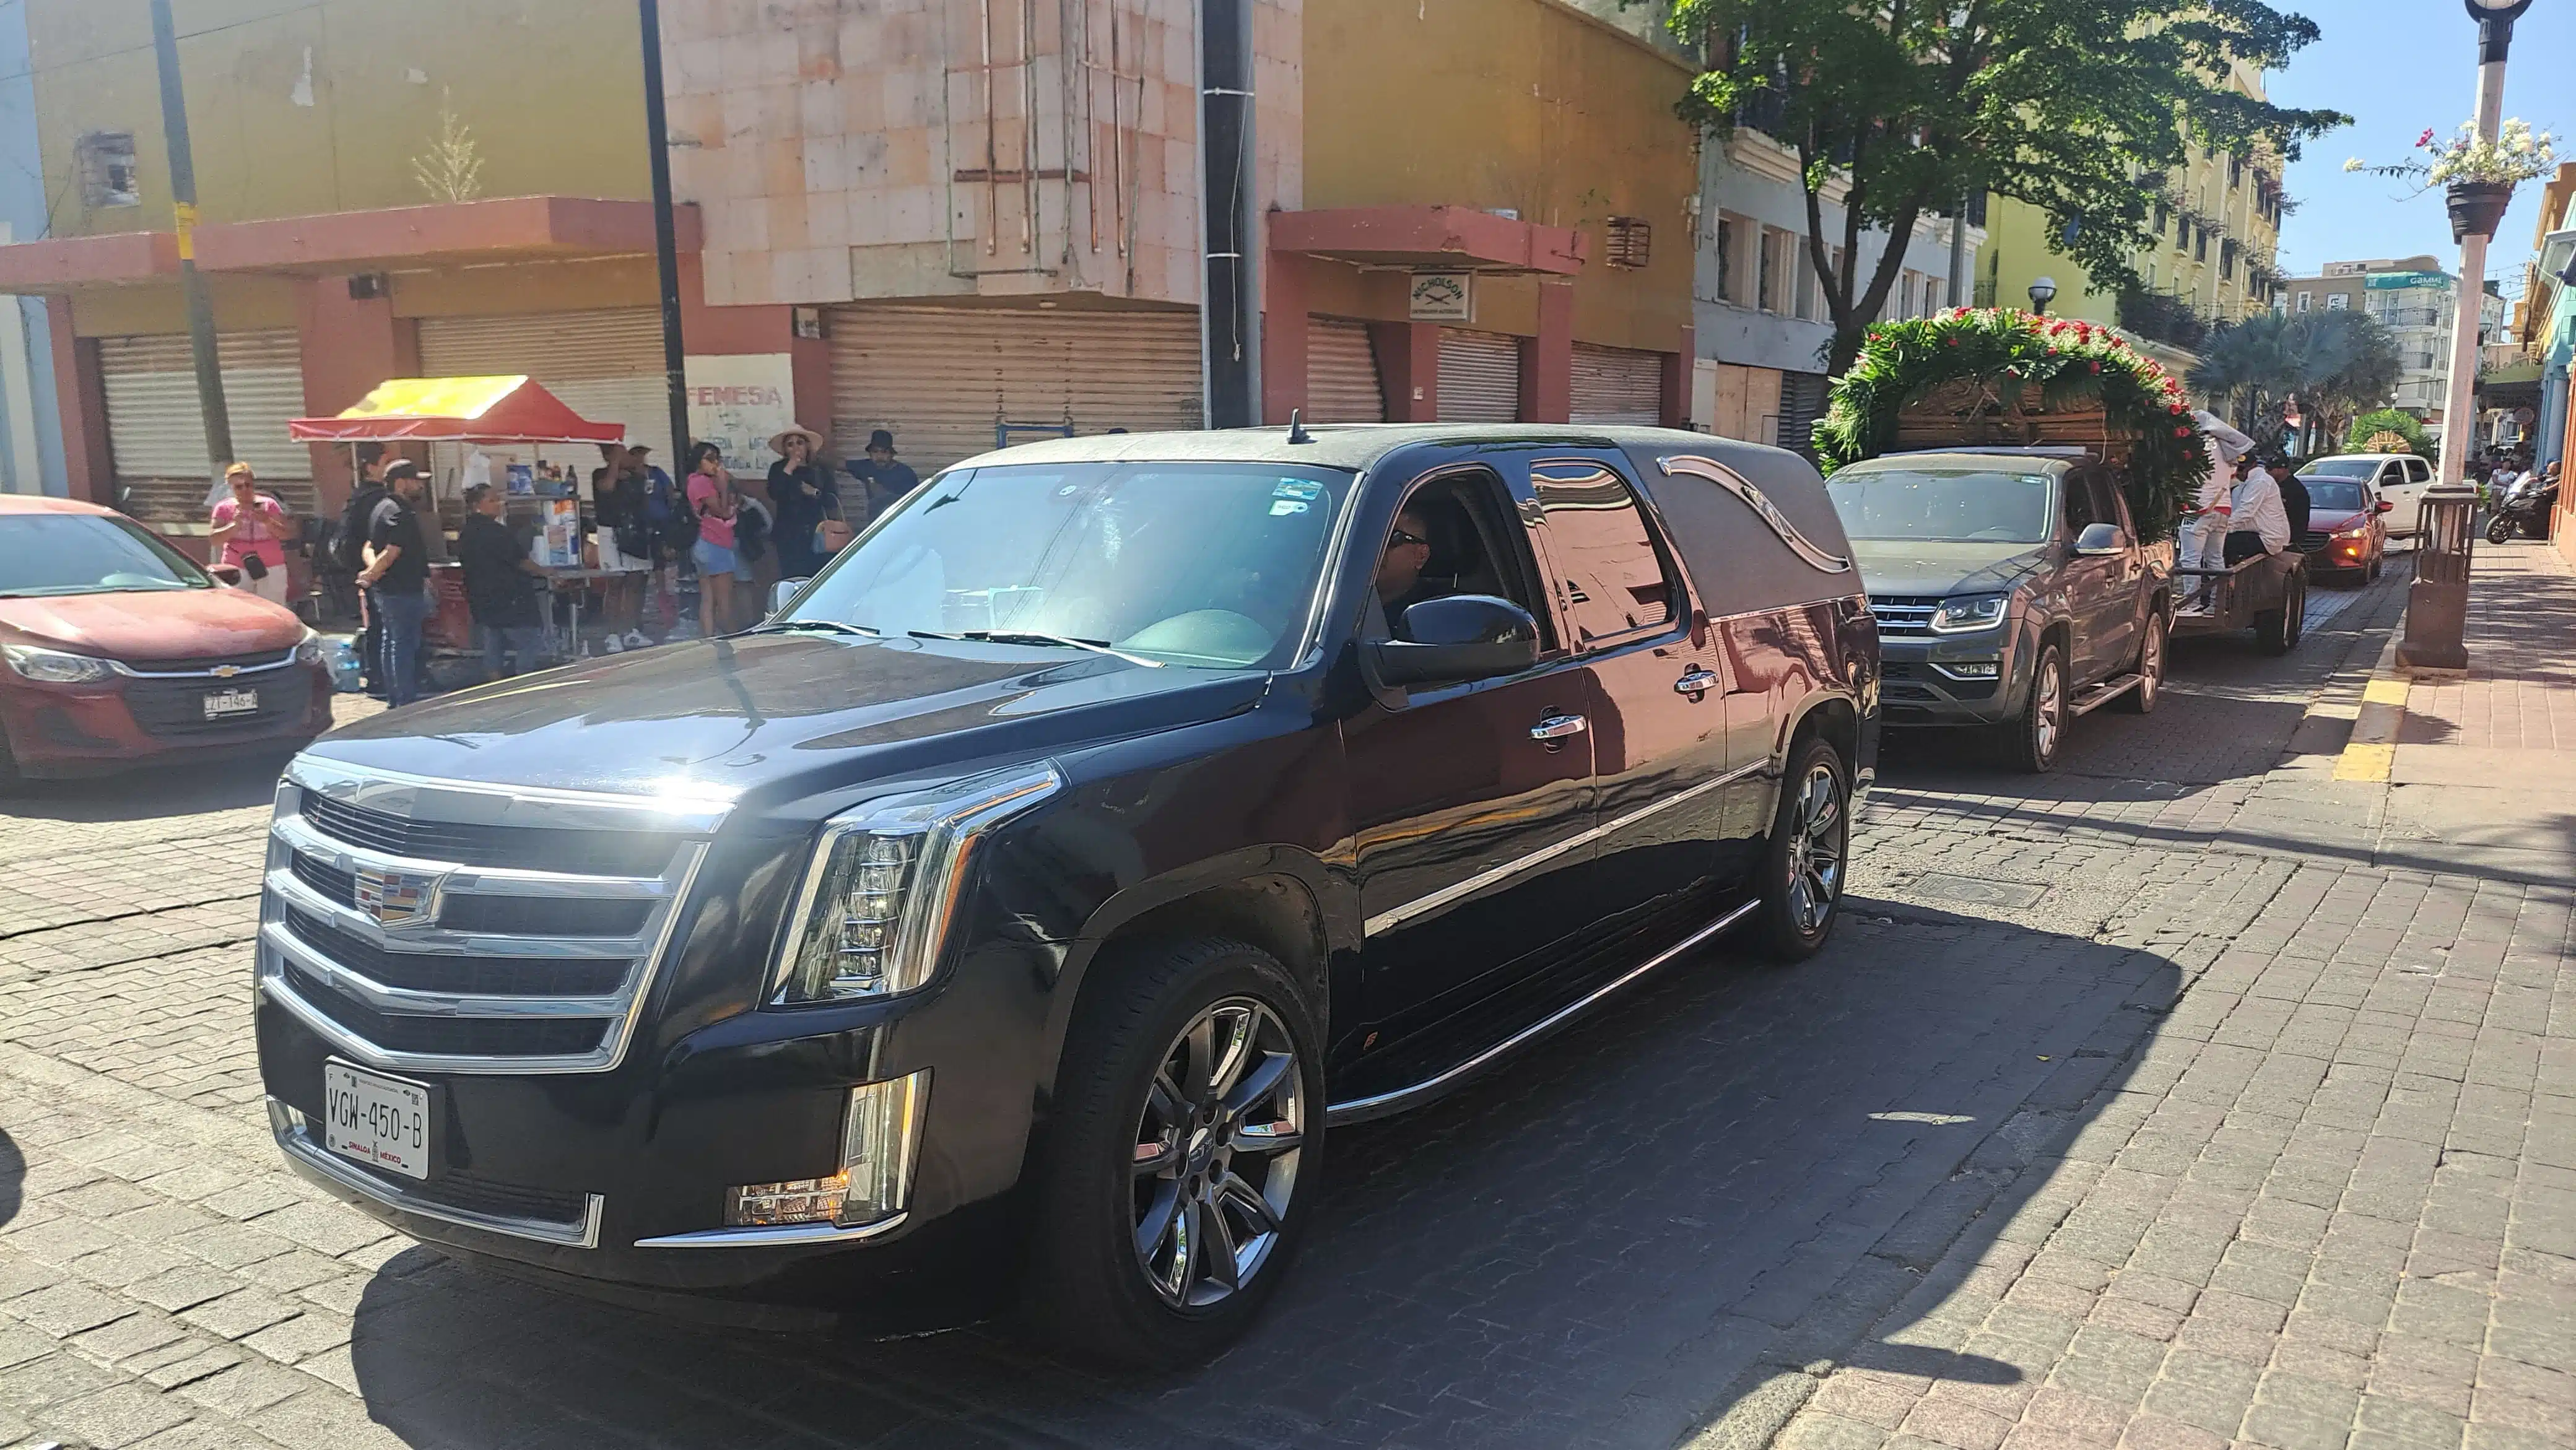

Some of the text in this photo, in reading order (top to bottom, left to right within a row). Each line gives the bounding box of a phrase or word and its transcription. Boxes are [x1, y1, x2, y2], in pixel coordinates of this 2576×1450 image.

[1412, 277, 1464, 300] NICHOLSON
[329, 1088, 422, 1149] VGW-450-B
[349, 1141, 371, 1154] SINALOA
